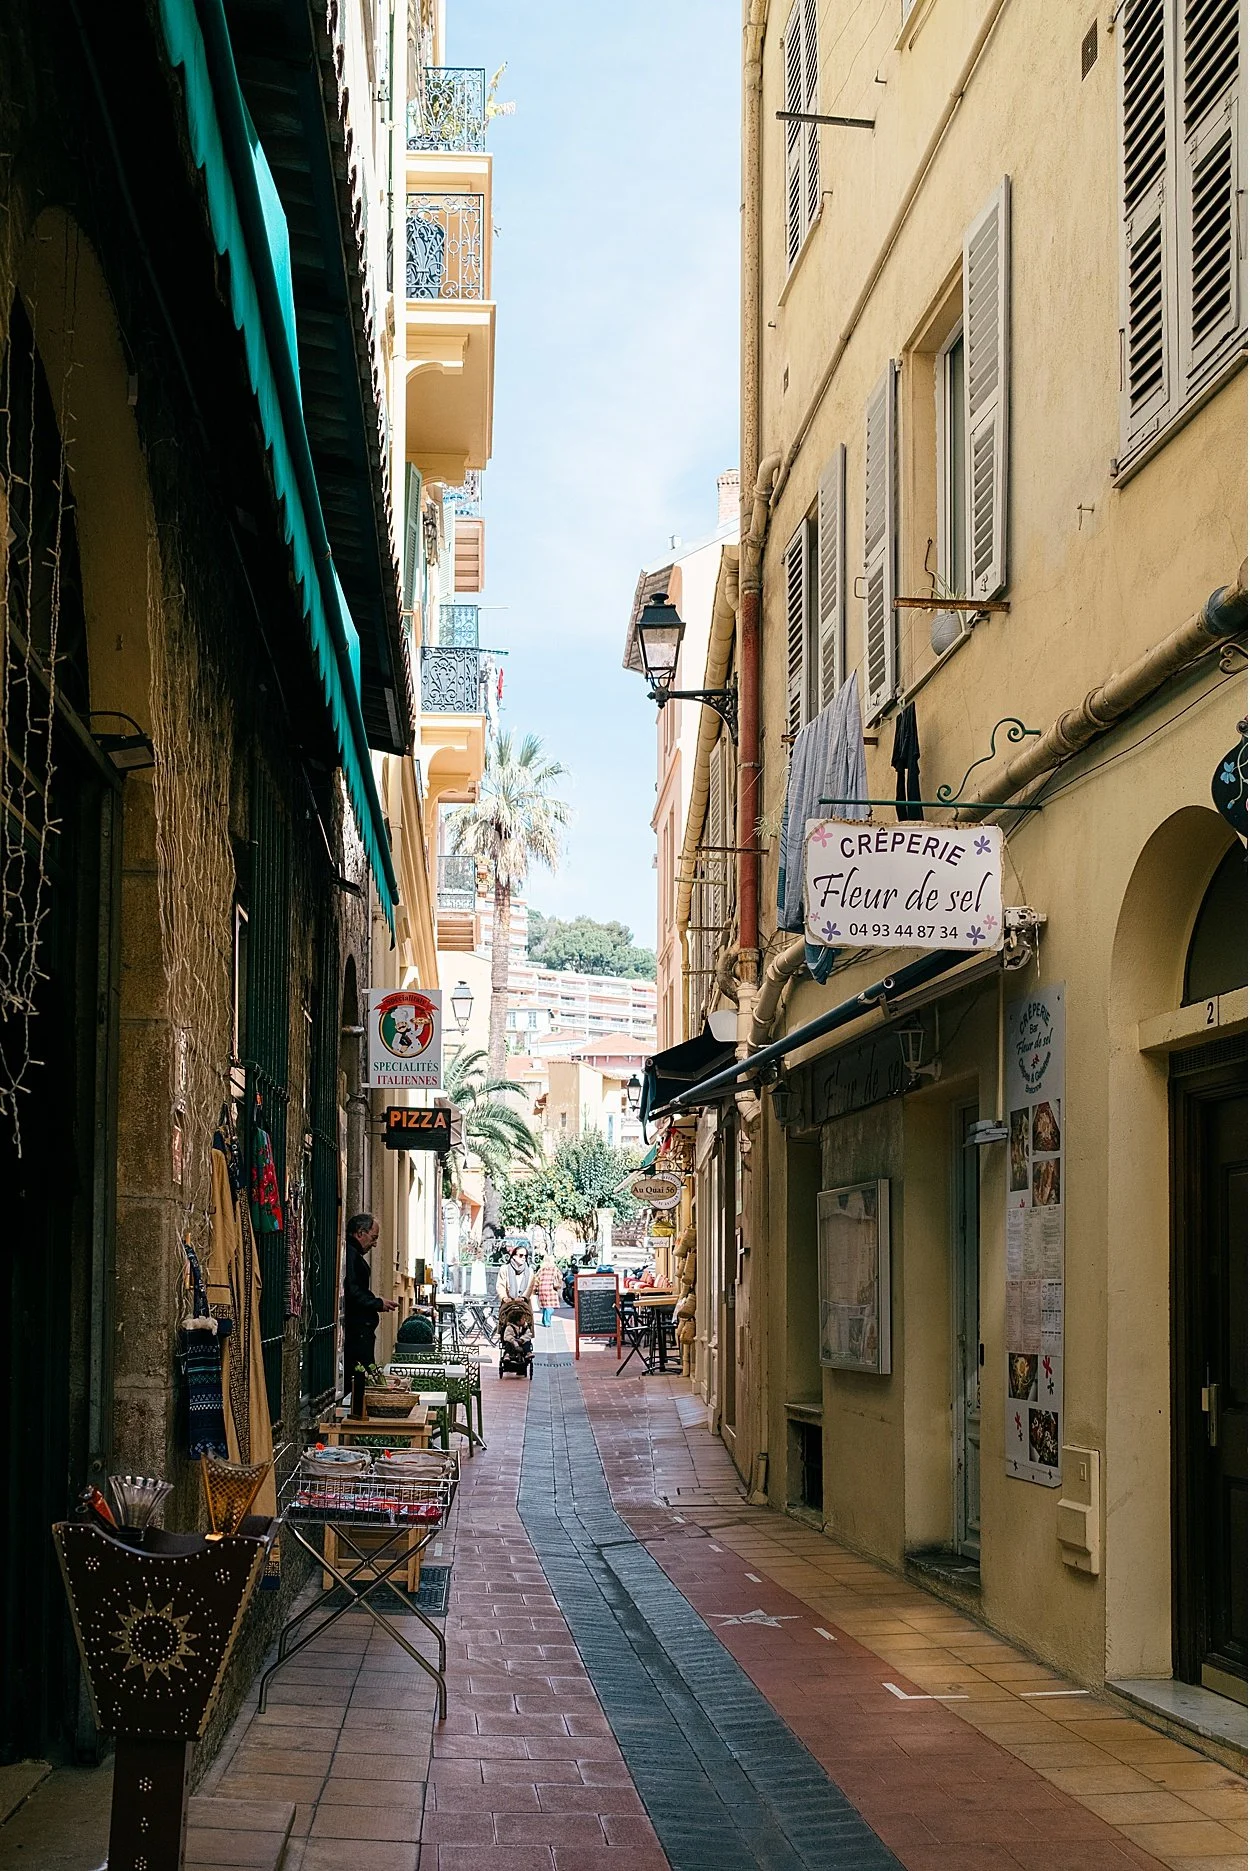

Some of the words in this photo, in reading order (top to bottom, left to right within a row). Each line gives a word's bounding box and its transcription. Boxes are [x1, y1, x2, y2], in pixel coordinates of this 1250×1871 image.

[840, 826, 967, 867] CRÊPERIE
[813, 866, 898, 909] Fleur
[904, 868, 939, 912] de
[944, 871, 993, 913] sel
[849, 923, 868, 936] 04
[872, 923, 890, 937] 93
[894, 924, 913, 938] 44
[917, 925, 935, 938] 87
[939, 926, 958, 939] 34
[1206, 1001, 1215, 1025] 2
[373, 1060, 439, 1072] SPECIALITÉS
[377, 1075, 438, 1086] ITALIENNES
[390, 1110, 447, 1129] PIZZA
[646, 1186, 664, 1195] Quai
[665, 1186, 675, 1194] 56
